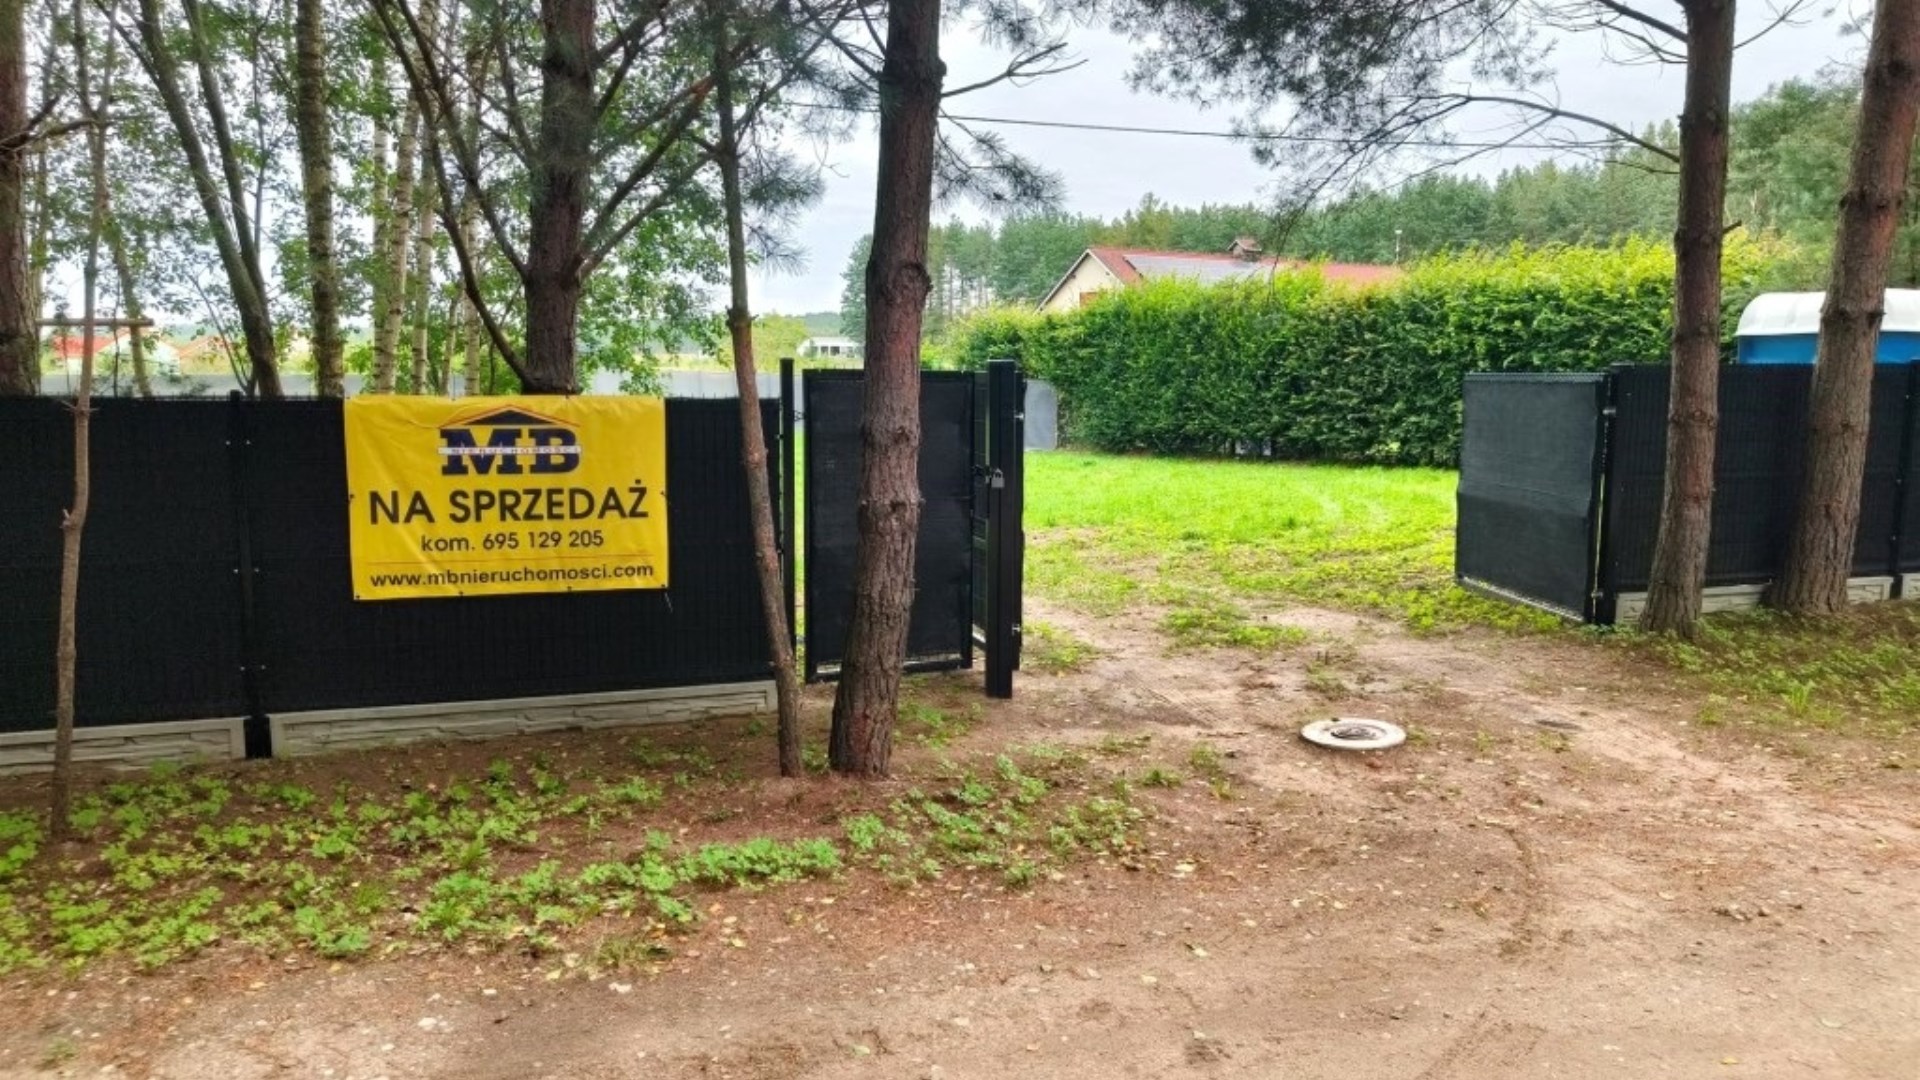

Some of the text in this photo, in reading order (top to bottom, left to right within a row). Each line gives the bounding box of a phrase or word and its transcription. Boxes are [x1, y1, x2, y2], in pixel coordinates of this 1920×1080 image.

[440, 428, 580, 475] MB
[369, 479, 649, 524] NA SPRZEDAŻ
[422, 530, 604, 552] kom. 695 129 205
[370, 564, 653, 587] www.mbnieruchomosci.com
